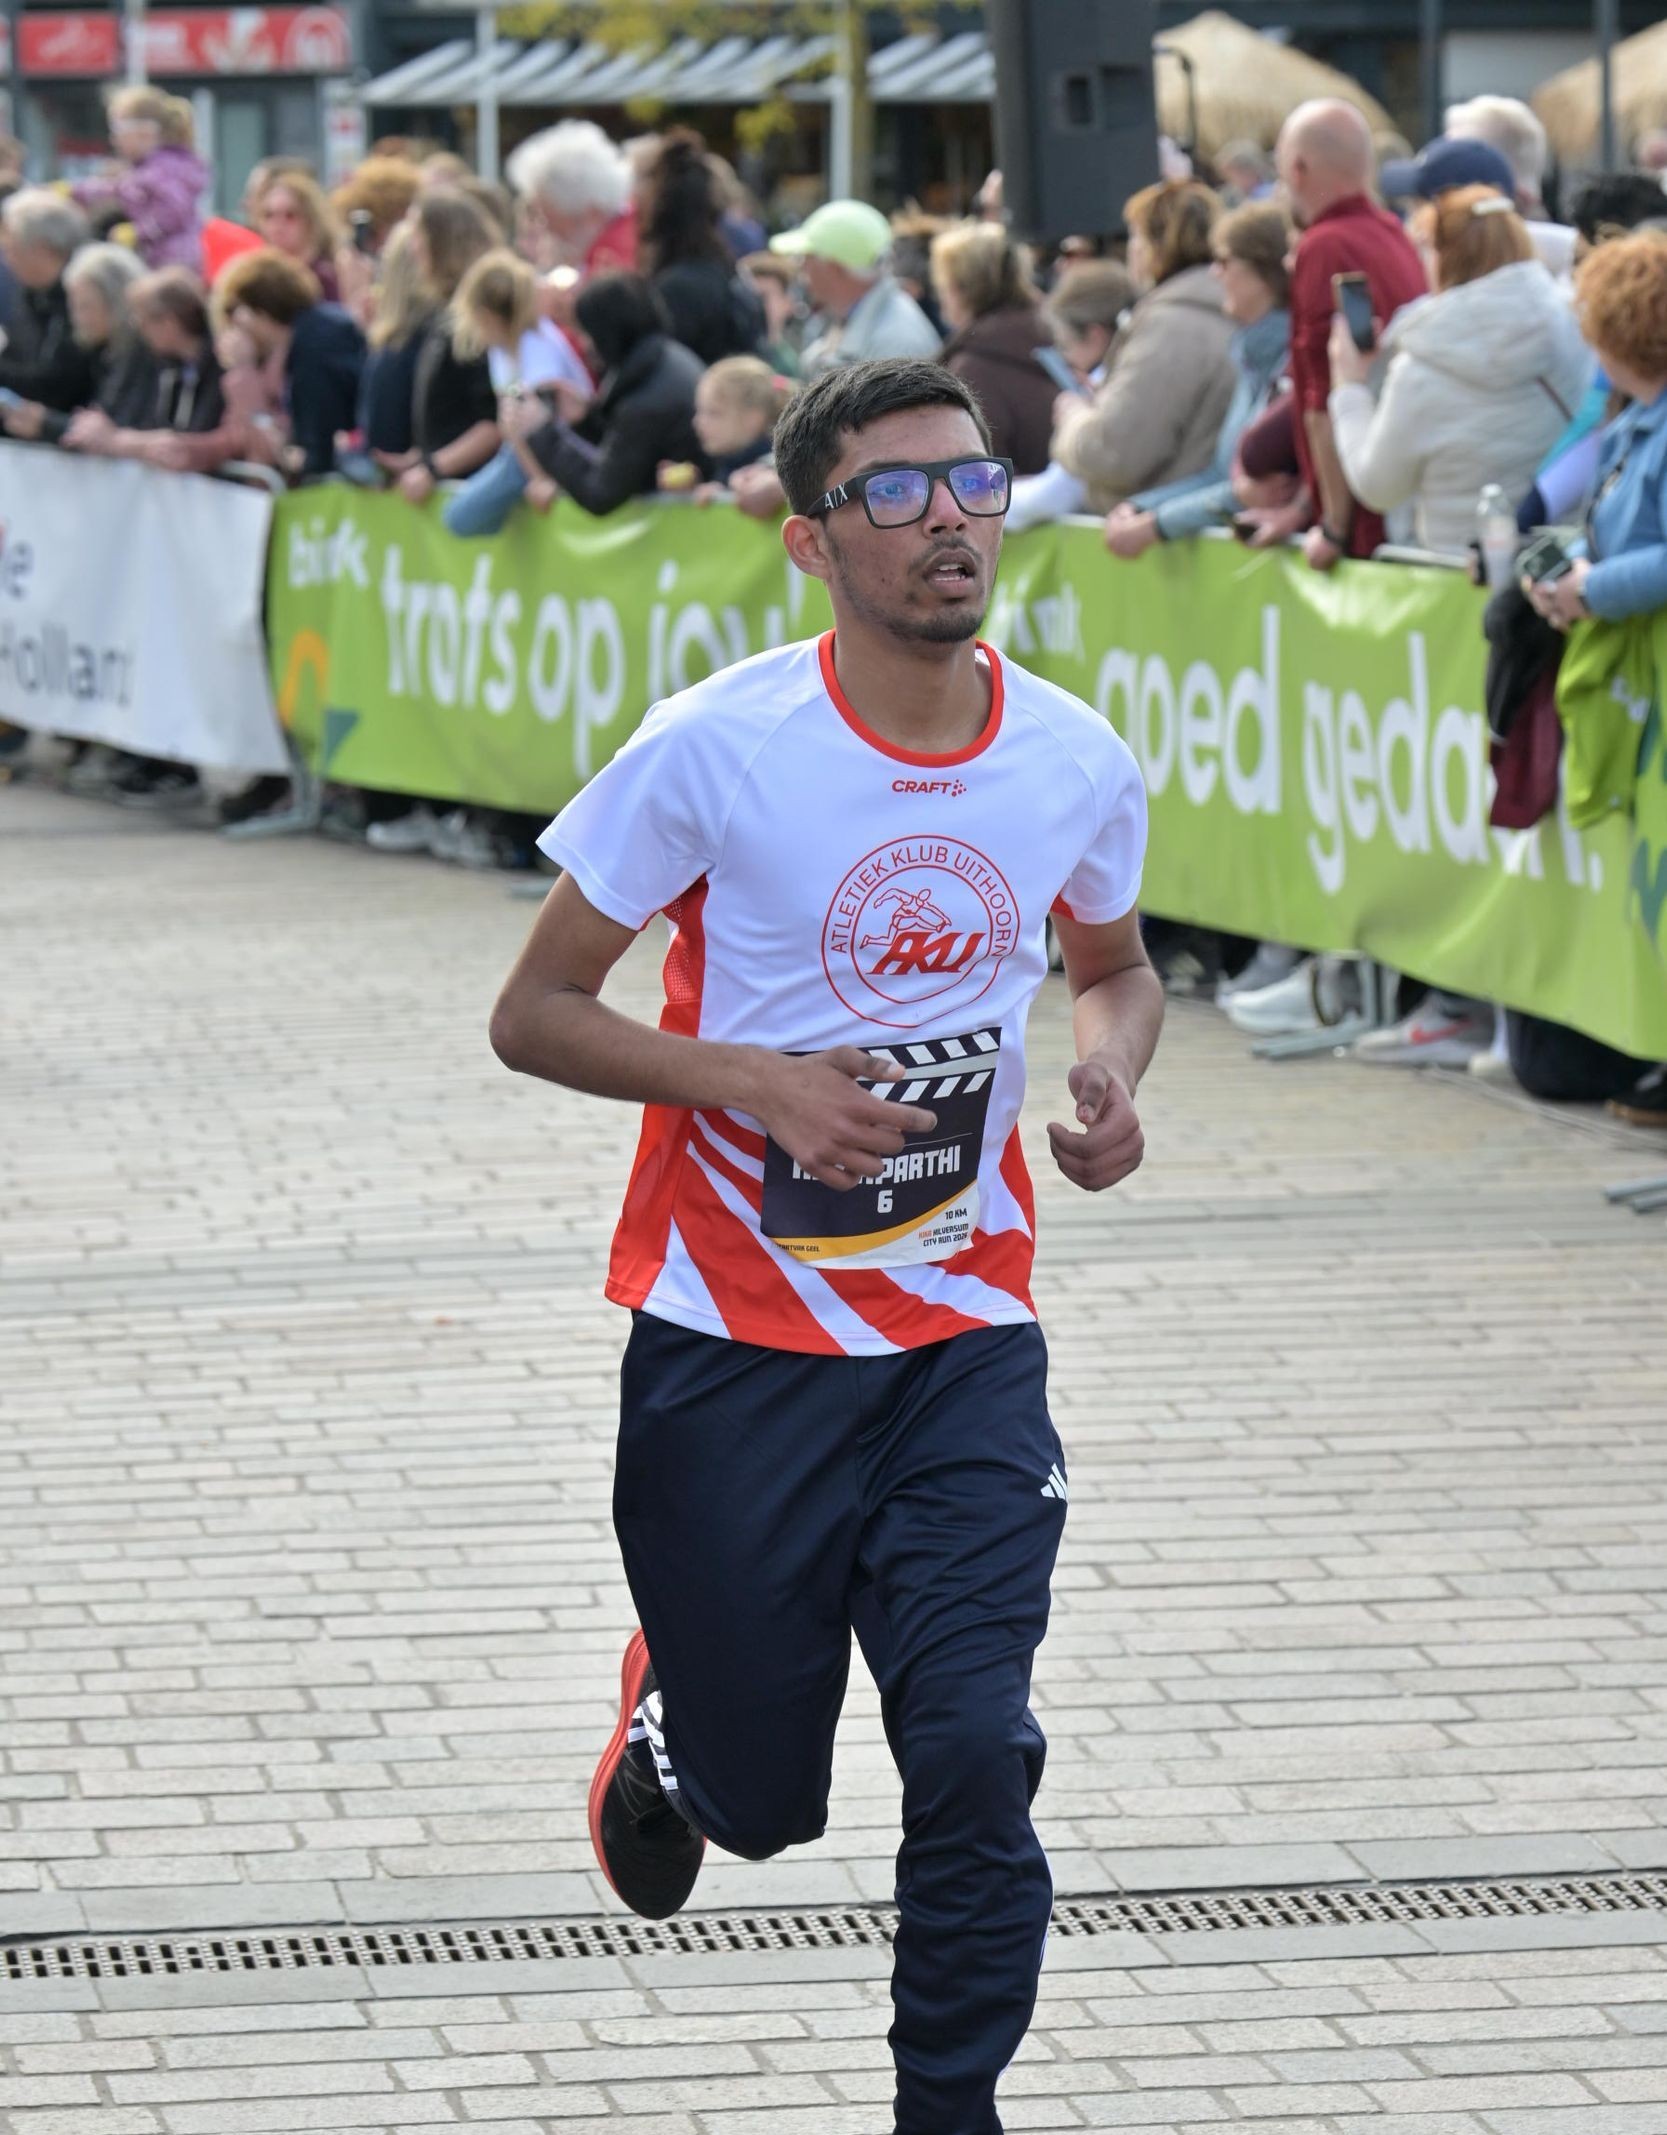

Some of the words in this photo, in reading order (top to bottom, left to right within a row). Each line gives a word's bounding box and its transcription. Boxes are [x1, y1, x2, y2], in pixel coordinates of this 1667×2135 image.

[381, 544, 522, 716] trots
[527, 593, 625, 779] op
[892, 780, 951, 794] CRAFT
[831, 857, 889, 953] ATLETIEK
[891, 845, 949, 867] KLUB
[954, 851, 1013, 958] UITHOORN
[866, 931, 986, 975] AKU
[793, 1145, 961, 1185] PARTHI
[877, 1190, 893, 1213] 6
[945, 1211, 953, 1220] 10
[955, 1208, 967, 1218] KM
[933, 1223, 969, 1236] HILVERSUM
[776, 1243, 805, 1252] TARTVAK
[806, 1245, 820, 1253] GEEL
[923, 1238, 937, 1247] CITY
[939, 1236, 952, 1244] RUN
